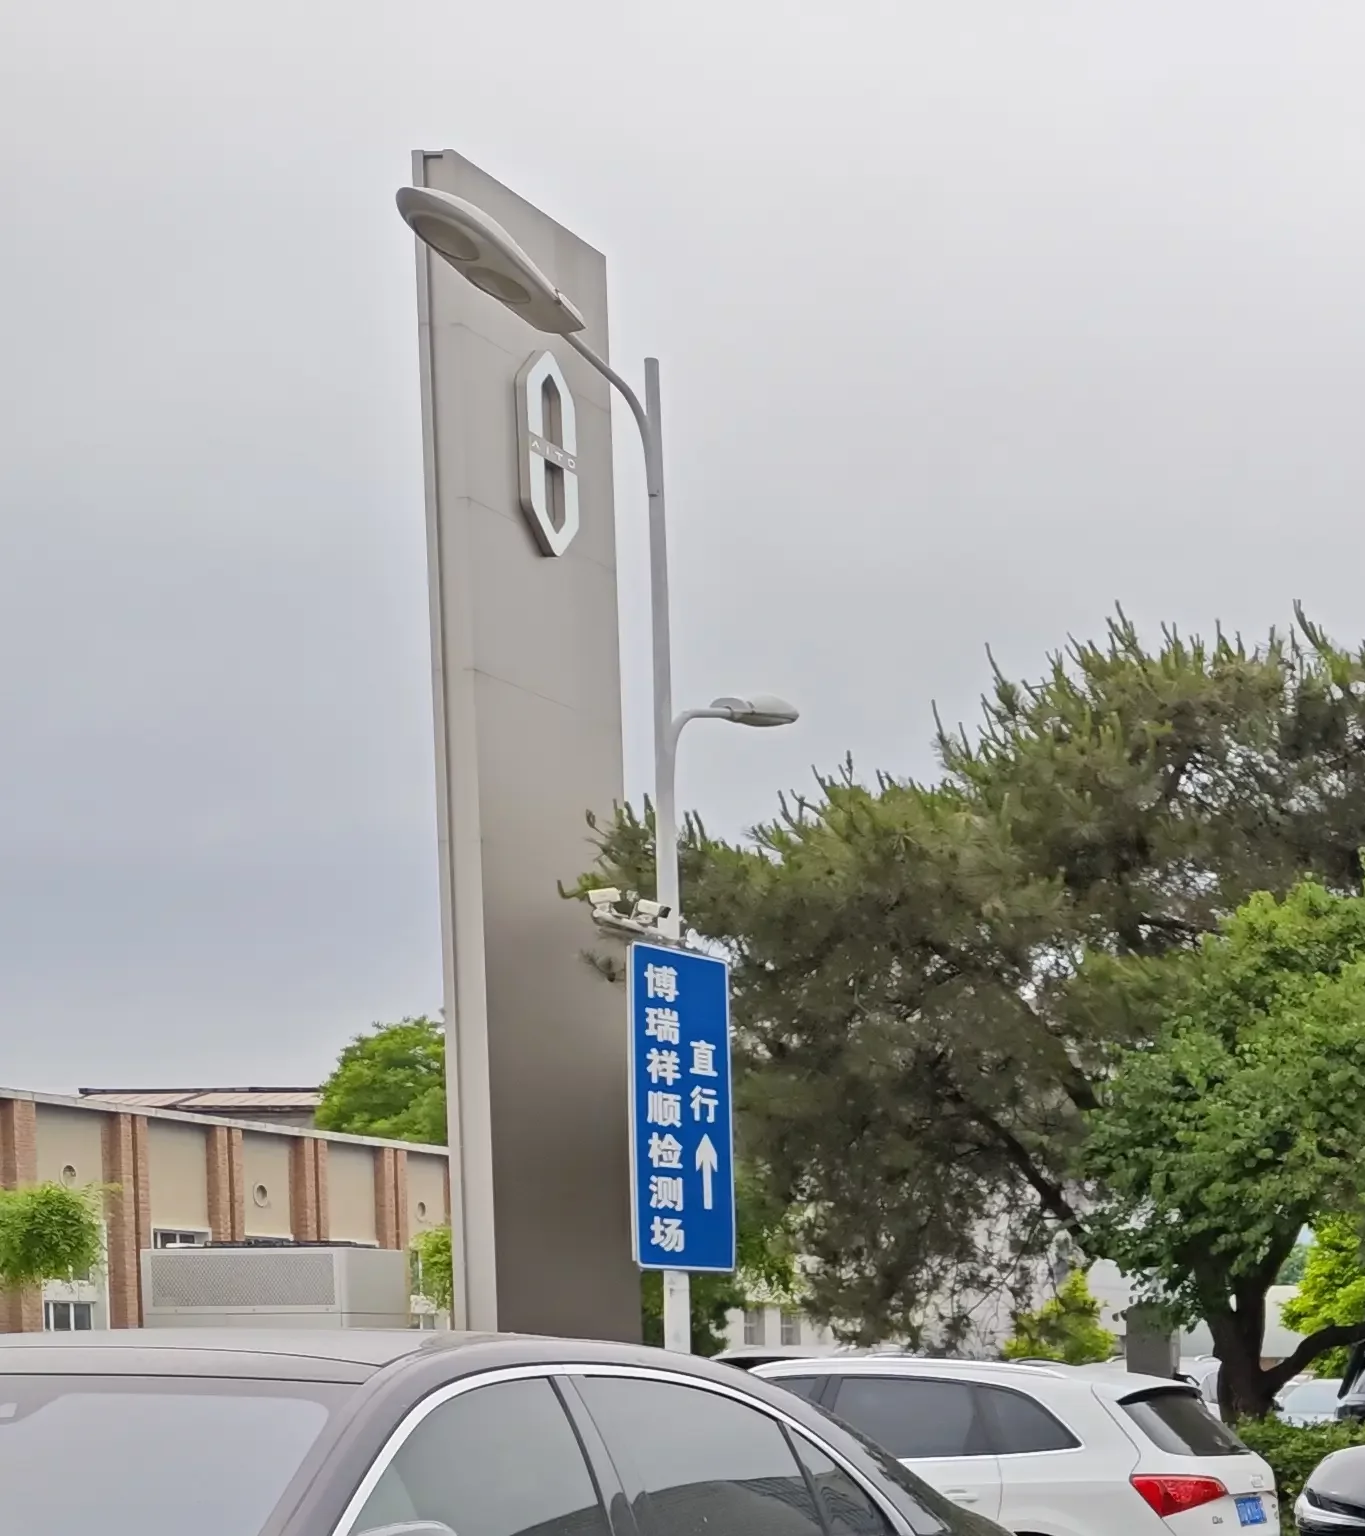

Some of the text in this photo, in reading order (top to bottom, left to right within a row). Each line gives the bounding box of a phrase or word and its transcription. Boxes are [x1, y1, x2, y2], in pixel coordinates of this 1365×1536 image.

[531, 440, 576, 469] AITO
[644, 963, 685, 1252] 博瑞祥顺检测场
[689, 1040, 718, 1123] 直行
